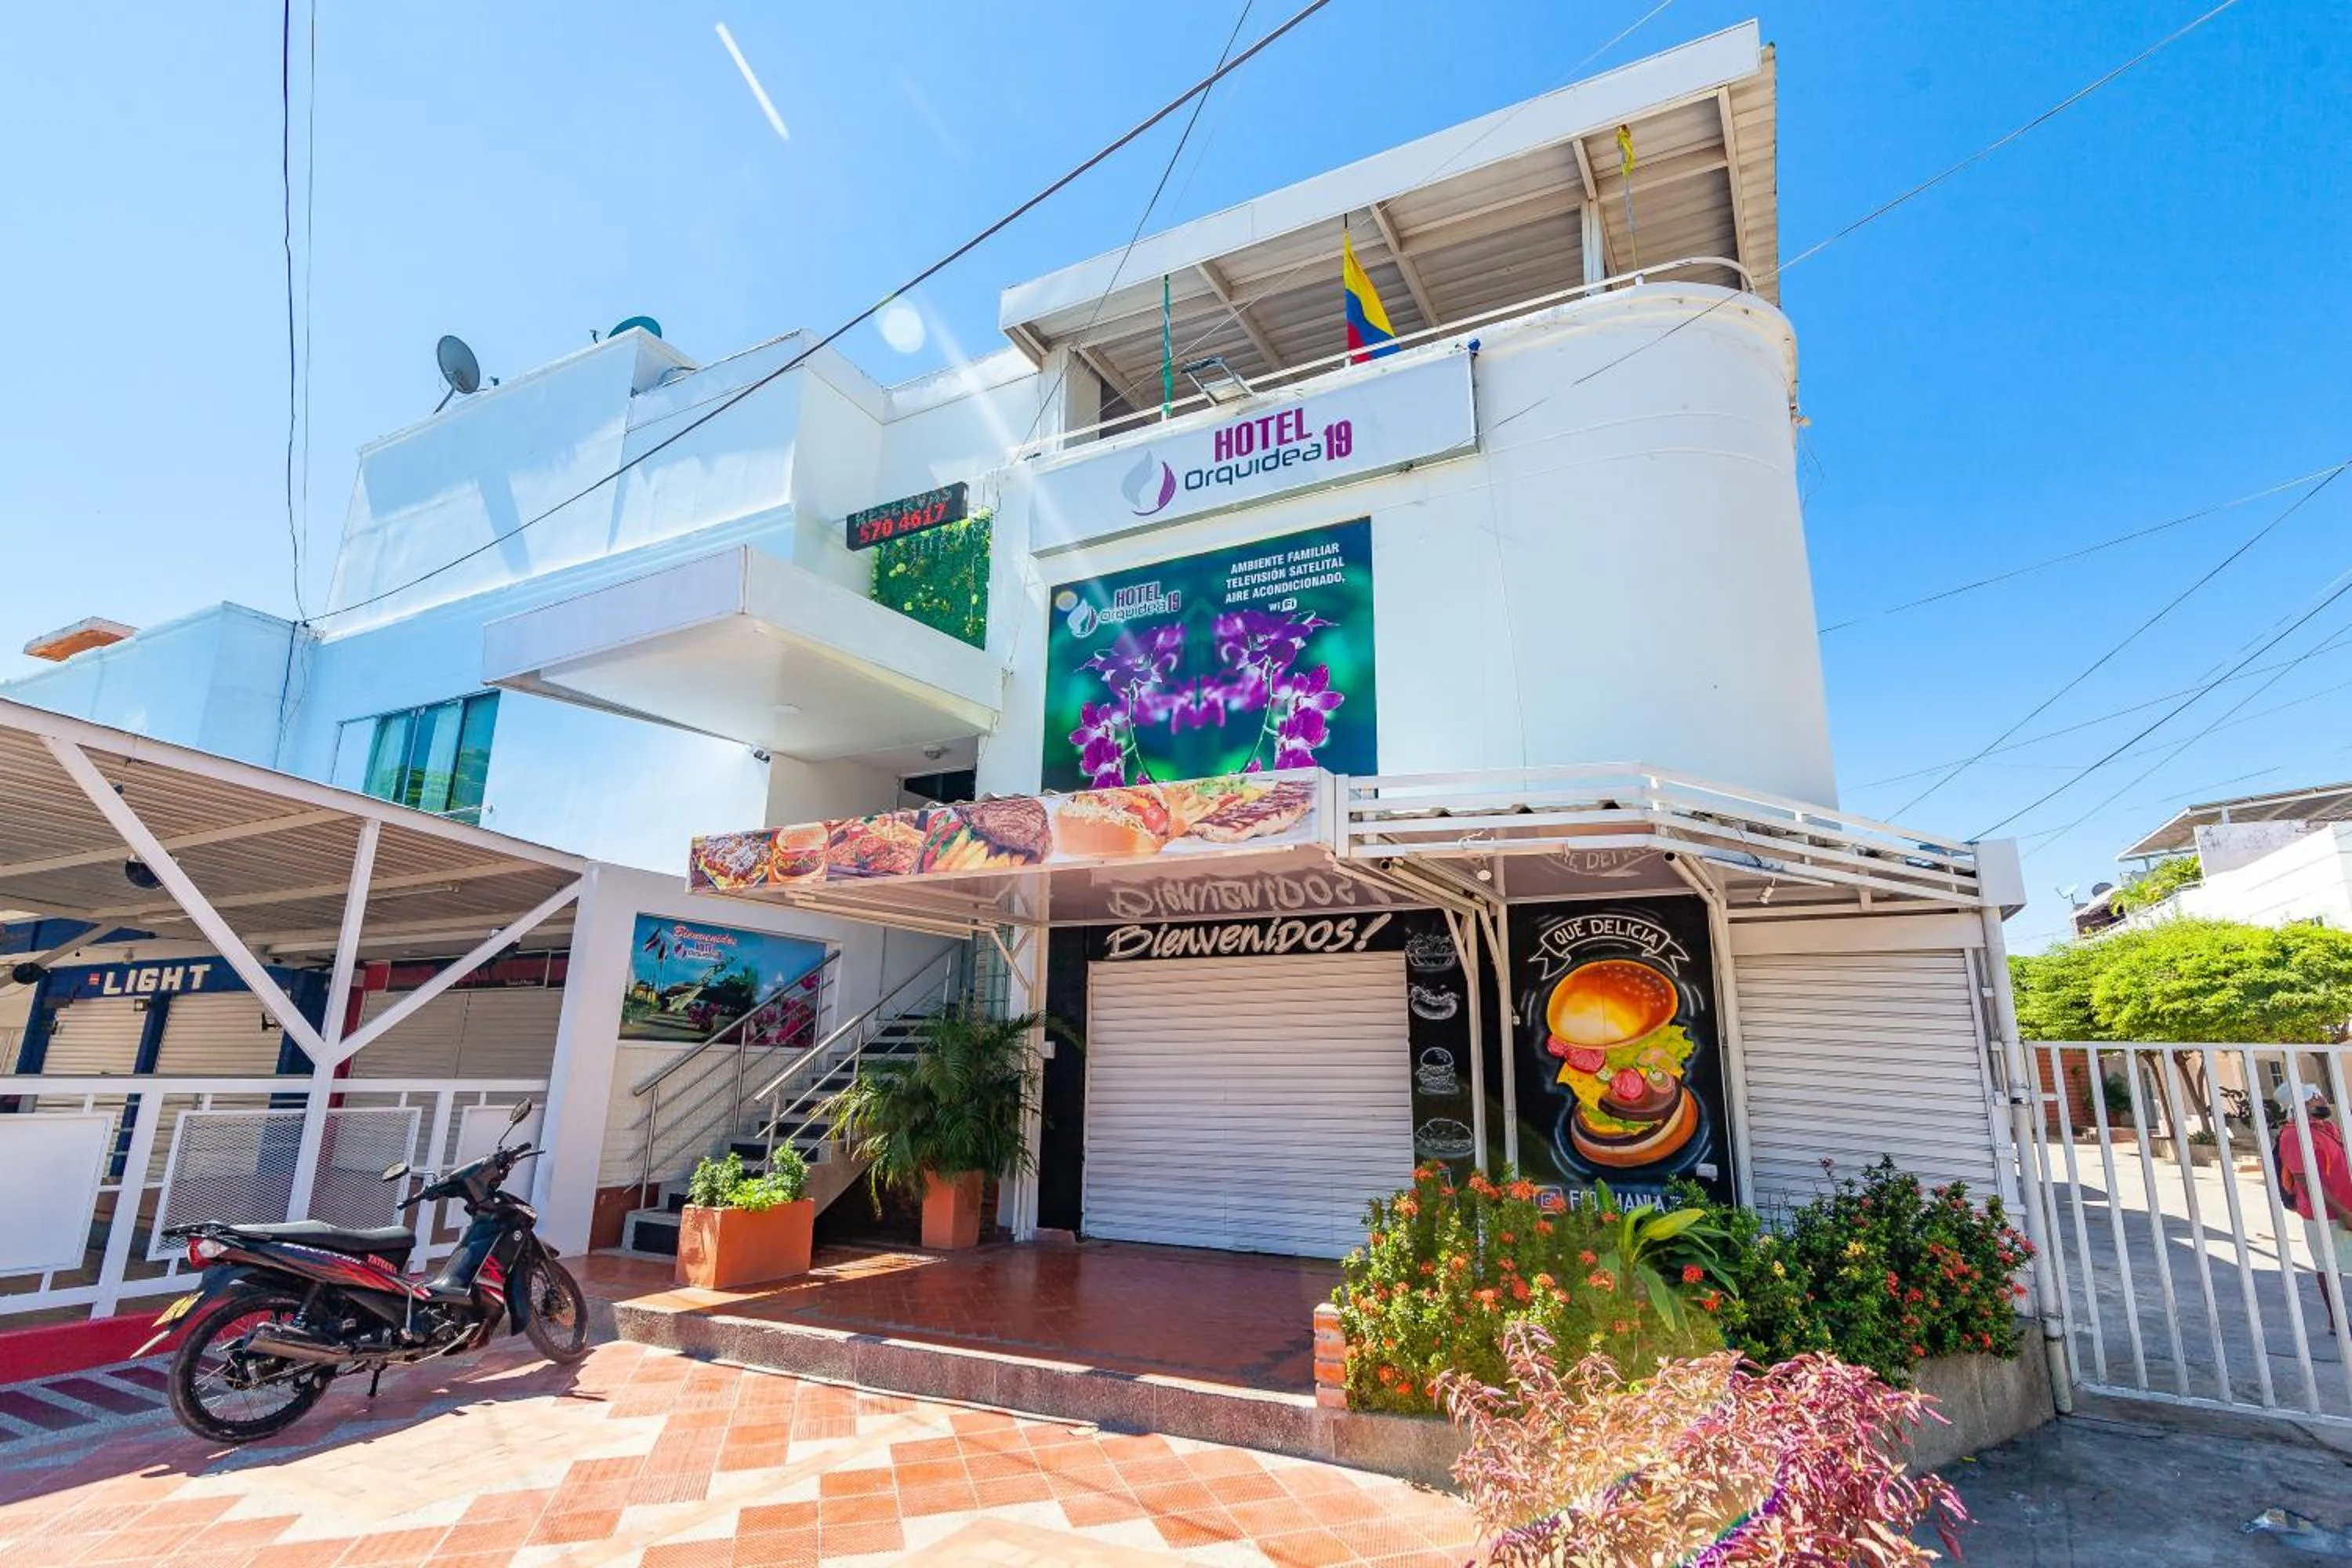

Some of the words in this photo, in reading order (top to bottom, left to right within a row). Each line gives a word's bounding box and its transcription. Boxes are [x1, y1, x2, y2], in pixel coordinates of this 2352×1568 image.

[1214, 407, 1313, 463] HOTEL
[1323, 419, 1352, 461] 19
[1225, 567, 1286, 590] TELEVISIÓN
[1288, 556, 1345, 577] SATELITAL
[1230, 554, 1285, 575] AMBIENTE
[1287, 542, 1340, 563] FAMILIAR
[1115, 581, 1163, 609] HOTEL
[1166, 589, 1181, 614] 19
[1225, 588, 1249, 604] AIRE
[1252, 572, 1346, 599] ACONDICIONADO,
[1589, 919, 1659, 948] DELICIA
[103, 964, 212, 995] LIGHT
